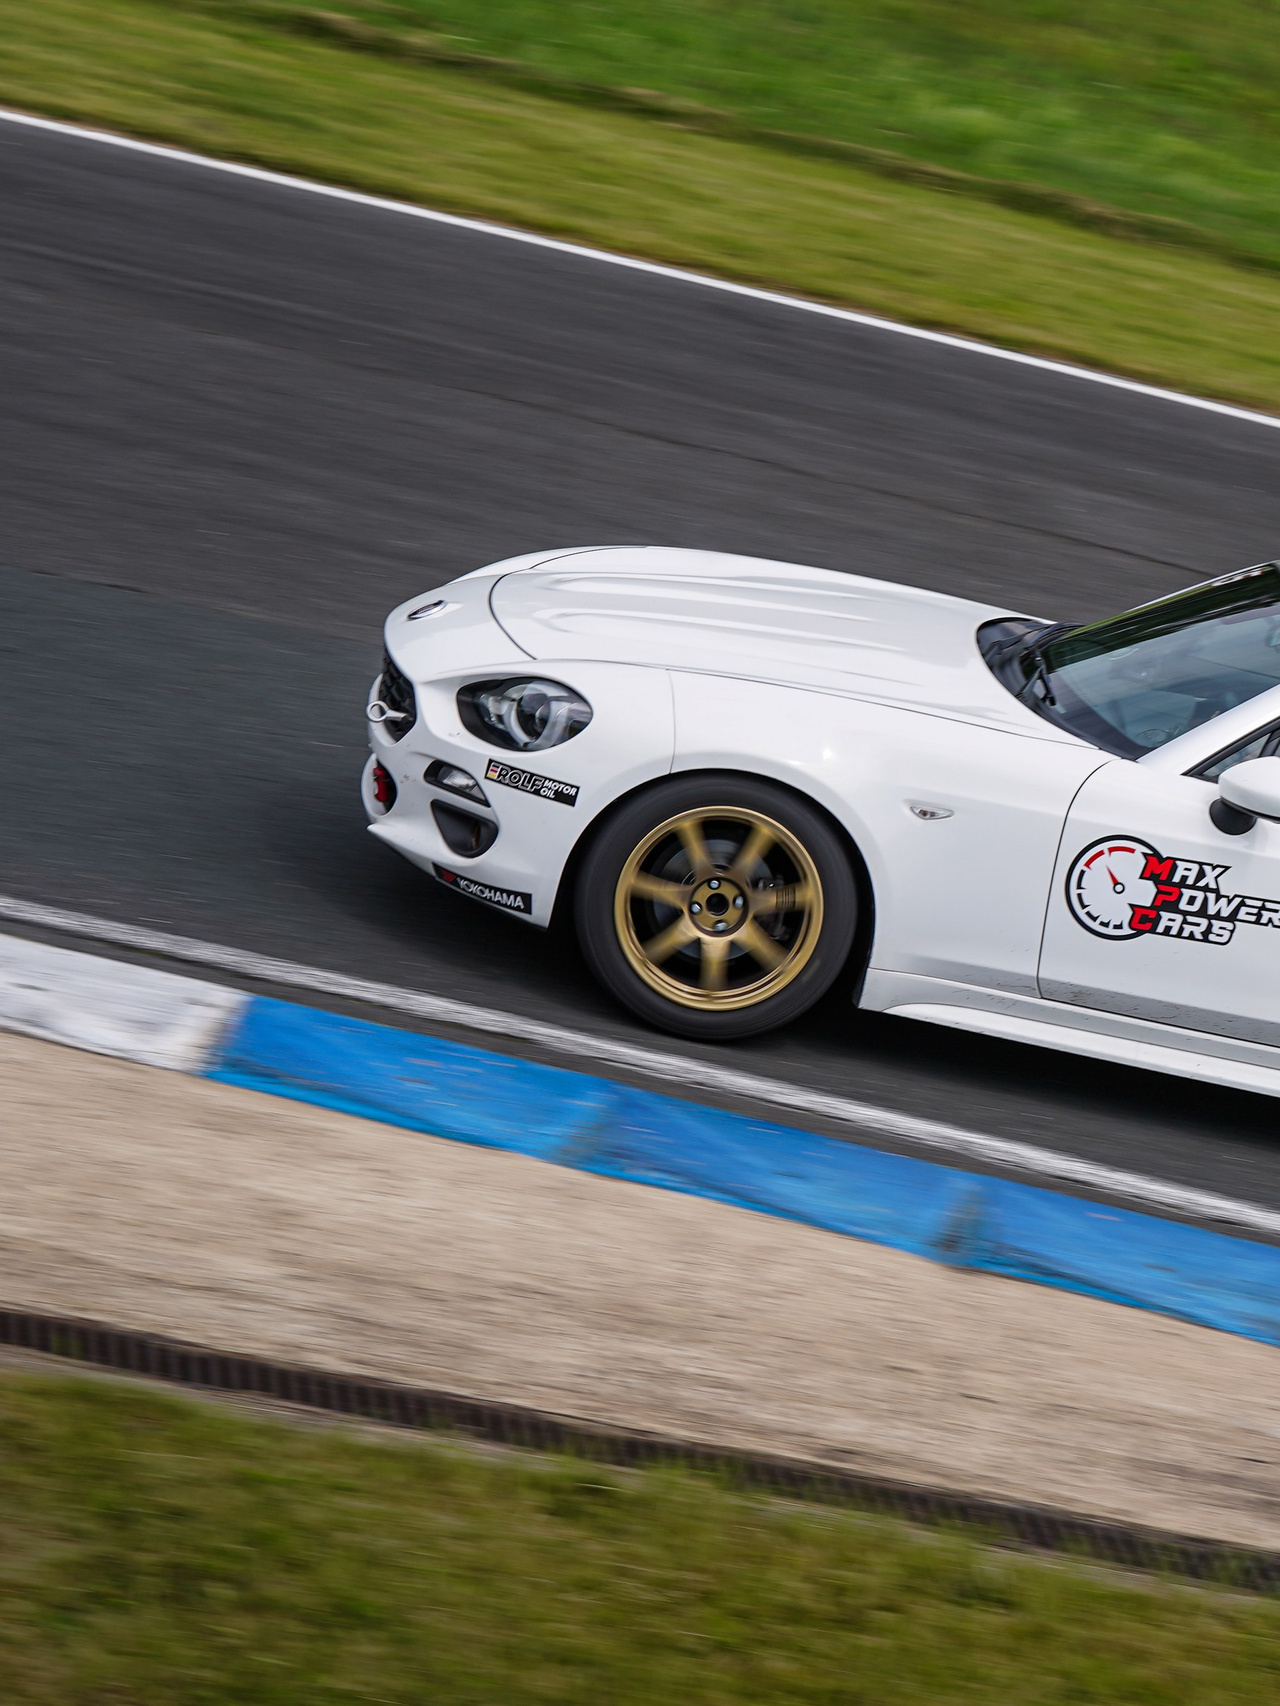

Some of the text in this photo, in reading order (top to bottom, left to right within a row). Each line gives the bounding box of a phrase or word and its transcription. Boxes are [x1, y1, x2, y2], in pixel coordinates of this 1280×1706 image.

[496, 764, 546, 792] ROLF
[540, 787, 556, 799] OIL
[543, 779, 578, 796] MOTOR
[1141, 853, 1228, 889] MAX
[456, 877, 525, 910] YOKOHAMA
[1129, 905, 1235, 944] CARS
